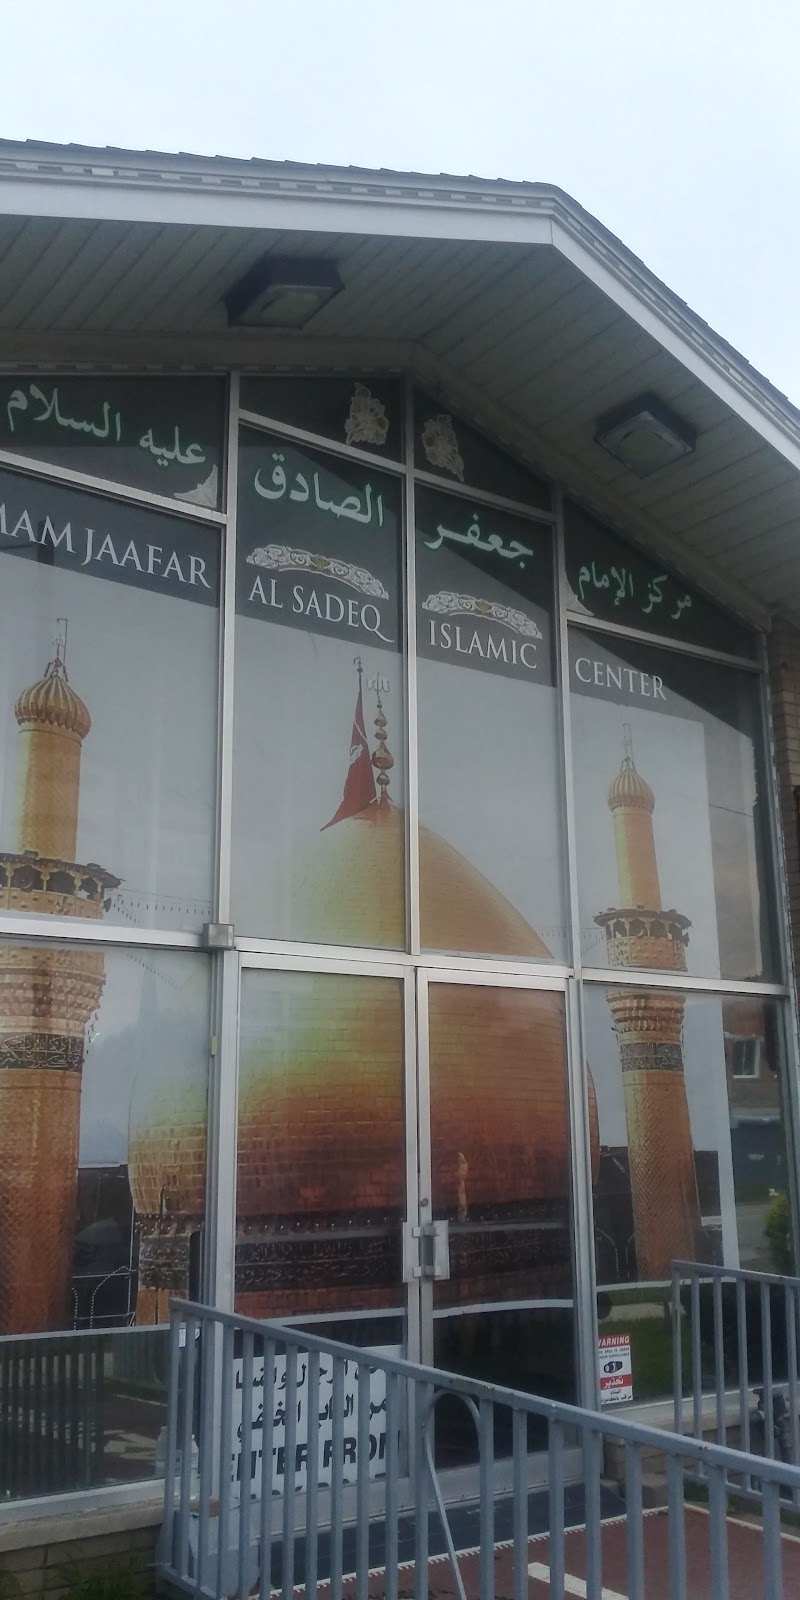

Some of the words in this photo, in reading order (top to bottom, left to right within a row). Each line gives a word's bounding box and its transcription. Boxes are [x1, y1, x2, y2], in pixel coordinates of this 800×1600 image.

[7, 384, 121, 441] السلام
[139, 426, 206, 467] عليه
[254, 453, 384, 528] الصادق
[424, 514, 534, 569] جعفر
[578, 560, 634, 606] الإمام
[641, 575, 692, 620] مركز
[81, 527, 212, 590] JAAFAR
[248, 575, 284, 610] AL
[292, 585, 395, 643] SADEQ
[428, 620, 538, 669] ISLAMIC
[575, 657, 667, 701] CENTER
